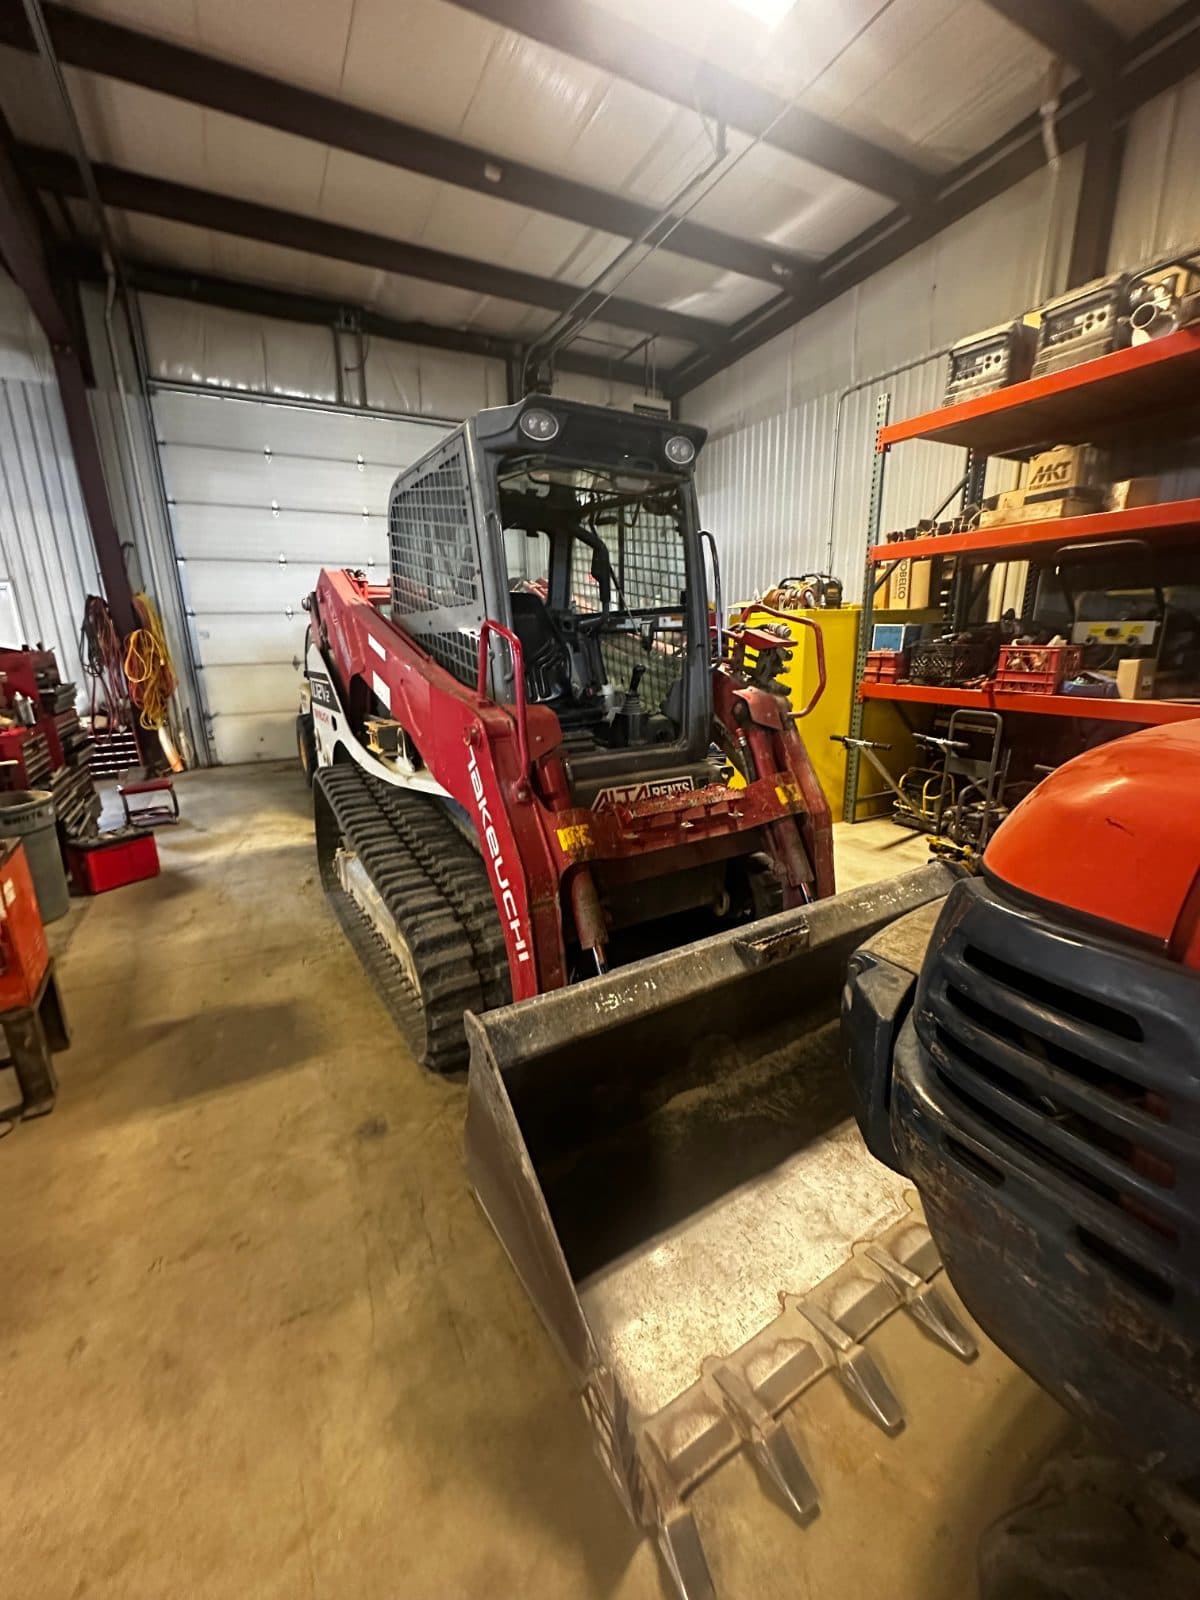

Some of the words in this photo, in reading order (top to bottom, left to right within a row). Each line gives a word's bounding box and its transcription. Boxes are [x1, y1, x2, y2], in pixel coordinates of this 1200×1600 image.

[1030, 461, 1071, 484] MKT
[591, 785, 649, 812] ALTA
[651, 781, 691, 798] RENTS
